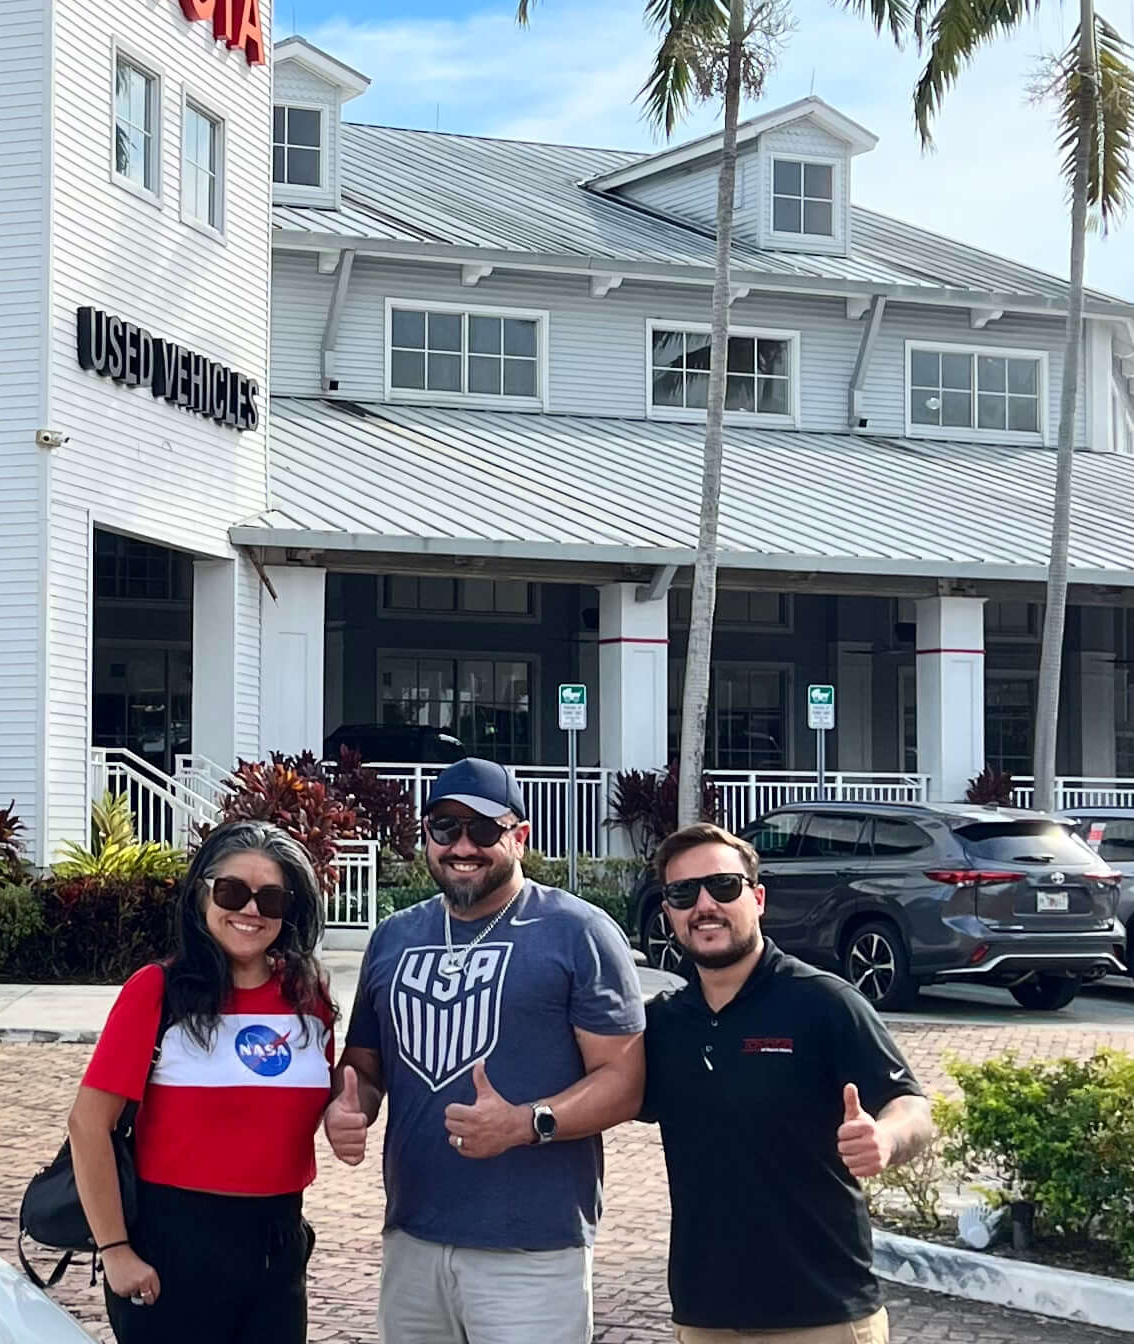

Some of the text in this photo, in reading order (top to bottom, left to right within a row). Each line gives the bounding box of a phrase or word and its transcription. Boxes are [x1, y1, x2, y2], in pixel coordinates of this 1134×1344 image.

[77, 305, 260, 432] USED VEHICLES
[401, 949, 501, 1002] USA
[239, 1043, 289, 1057] NASA
